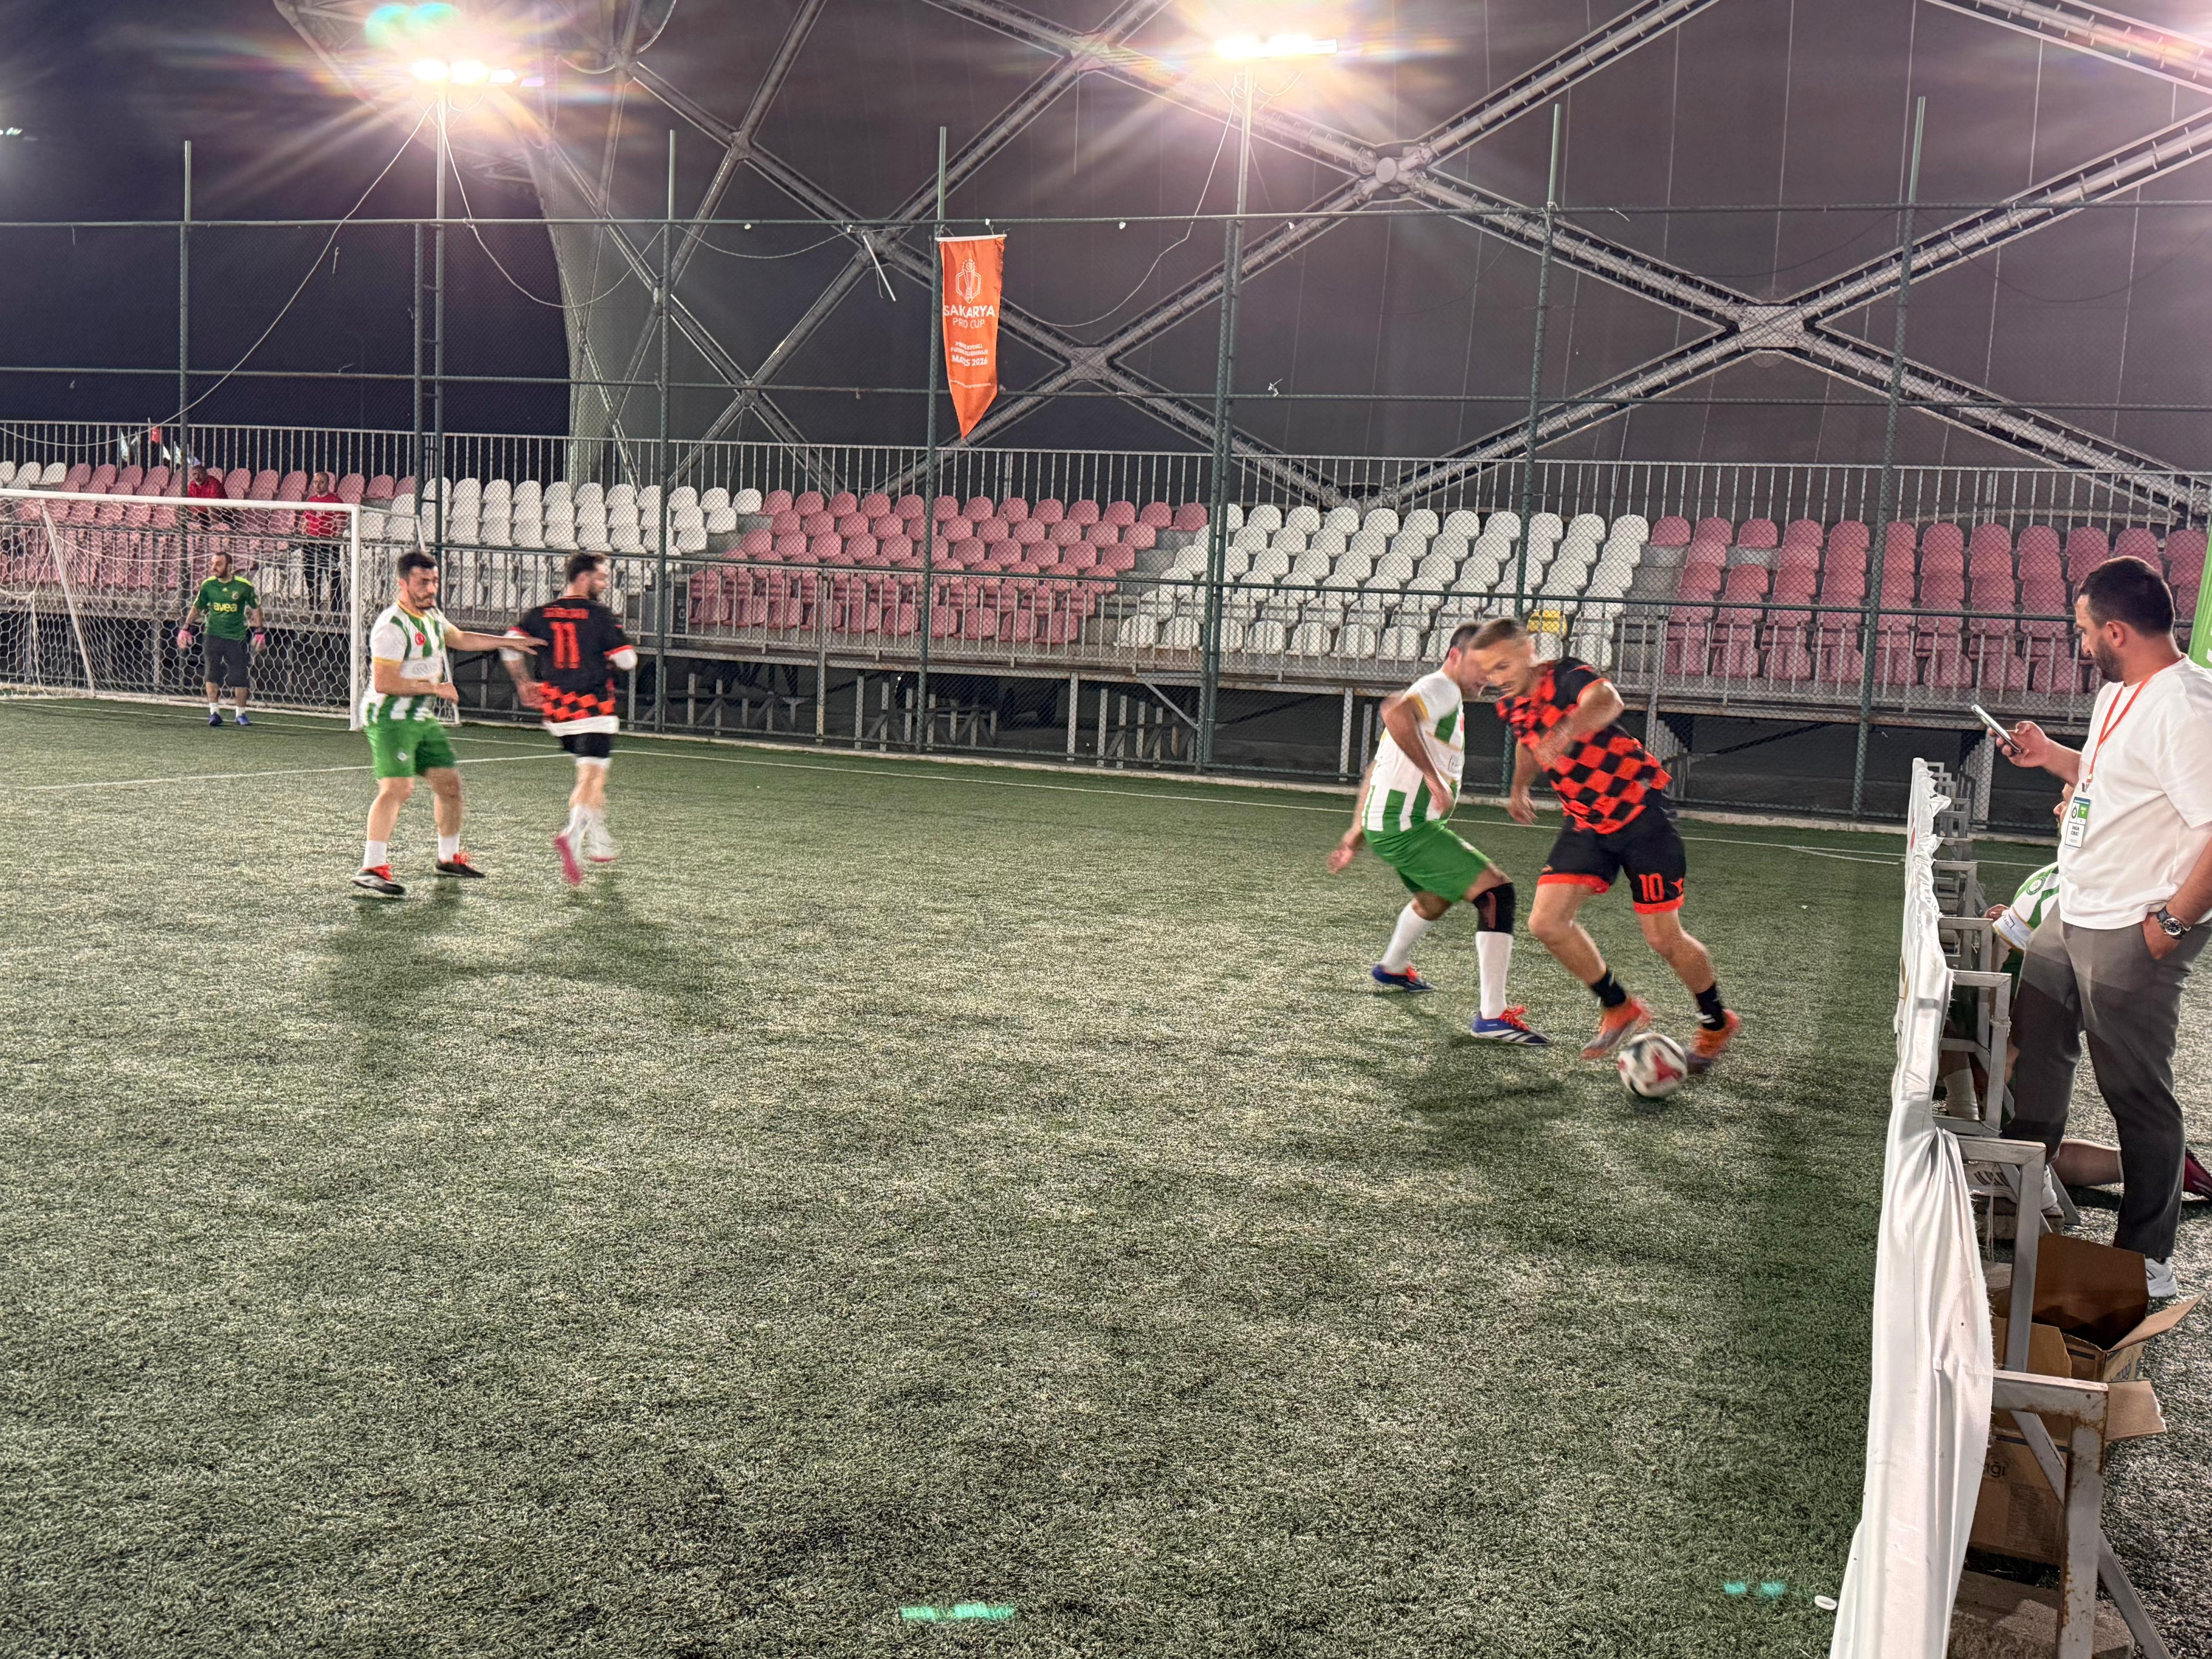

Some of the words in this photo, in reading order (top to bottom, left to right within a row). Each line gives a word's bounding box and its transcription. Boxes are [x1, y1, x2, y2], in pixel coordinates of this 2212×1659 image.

[943, 305, 995, 318] SAKARYA
[953, 318, 968, 328] PRO
[970, 319, 985, 328] CUP
[972, 357, 988, 366] 2026
[213, 602, 238, 612] avea
[550, 622, 580, 669] 11
[1639, 873, 1664, 902] 10
